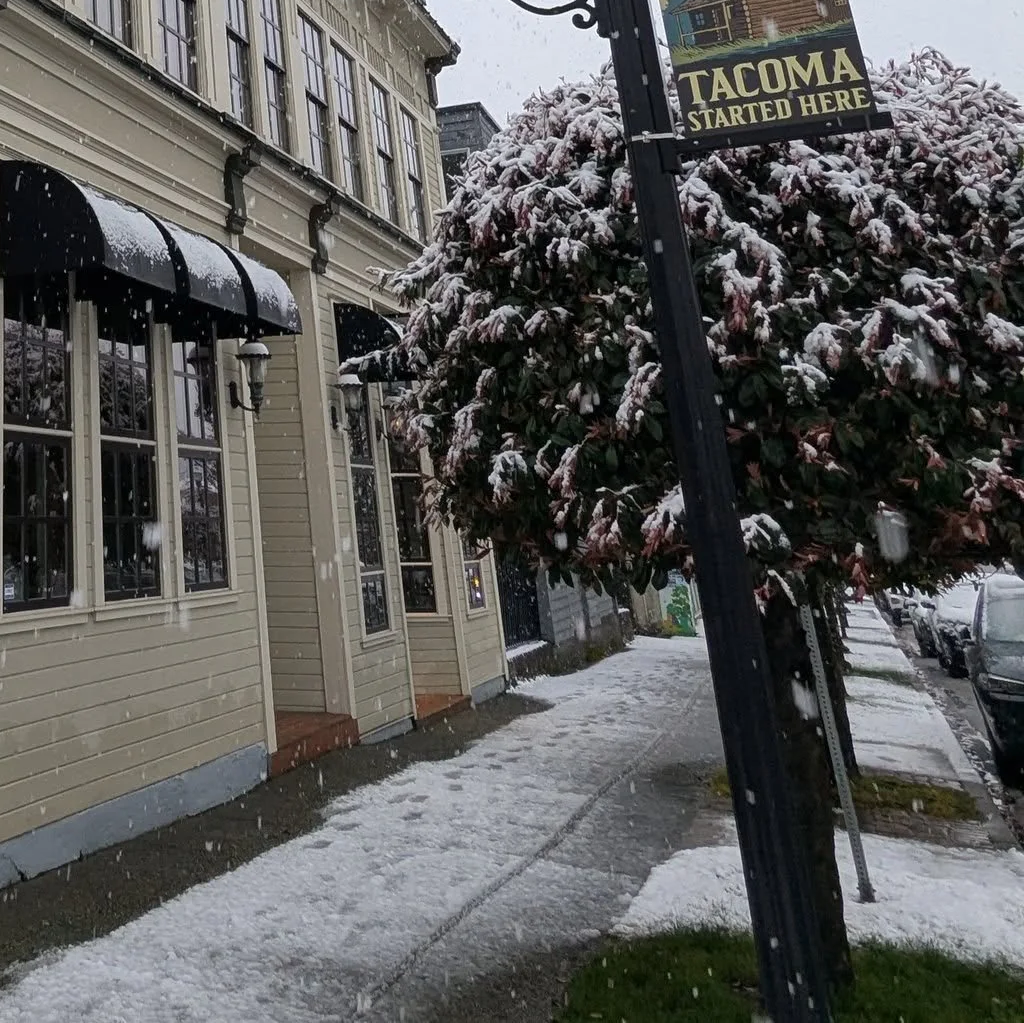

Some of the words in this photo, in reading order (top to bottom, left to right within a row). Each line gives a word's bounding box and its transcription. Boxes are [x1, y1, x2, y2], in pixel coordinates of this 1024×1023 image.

[678, 48, 864, 105] TACOMA
[687, 98, 791, 131] STARTED
[798, 87, 871, 117] HERE
